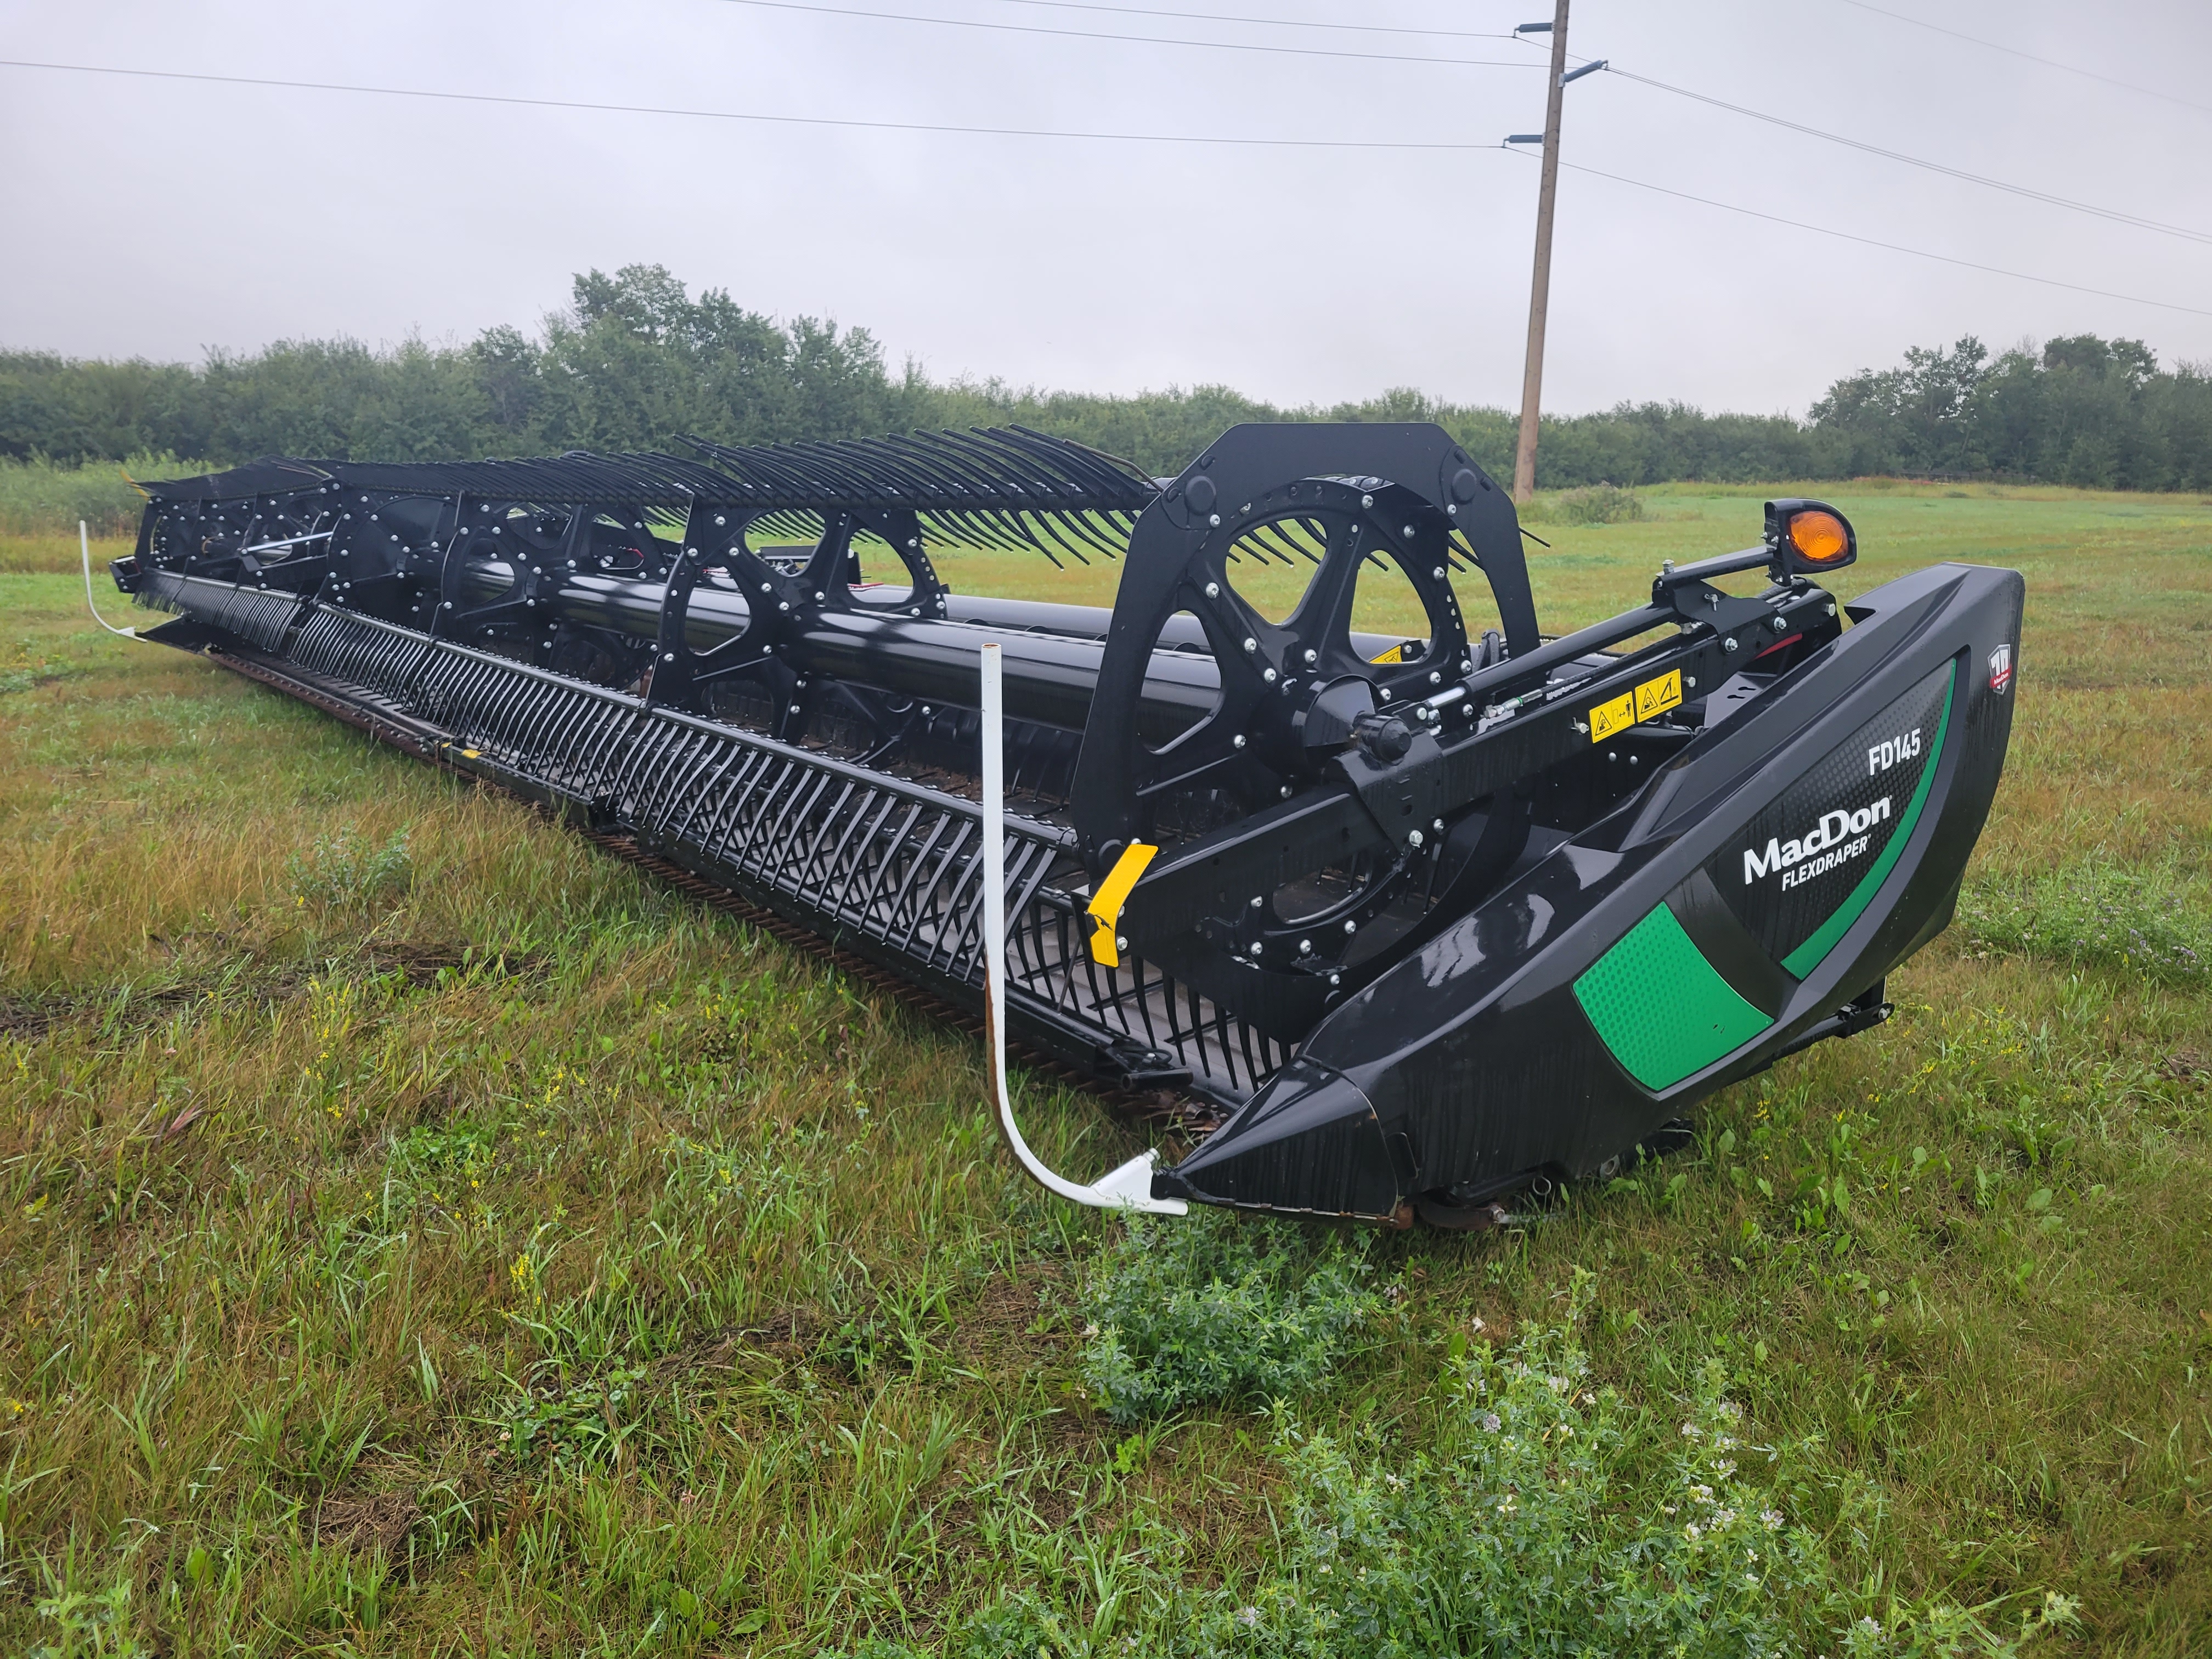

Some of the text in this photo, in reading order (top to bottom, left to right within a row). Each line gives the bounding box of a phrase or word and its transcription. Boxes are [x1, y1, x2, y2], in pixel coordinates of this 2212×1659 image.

[1994, 673, 2008, 685] MacDon
[1869, 727, 1921, 776] FD145
[1744, 797, 1891, 885] MacDon
[1782, 836, 1869, 891] FLEXDRAPER
